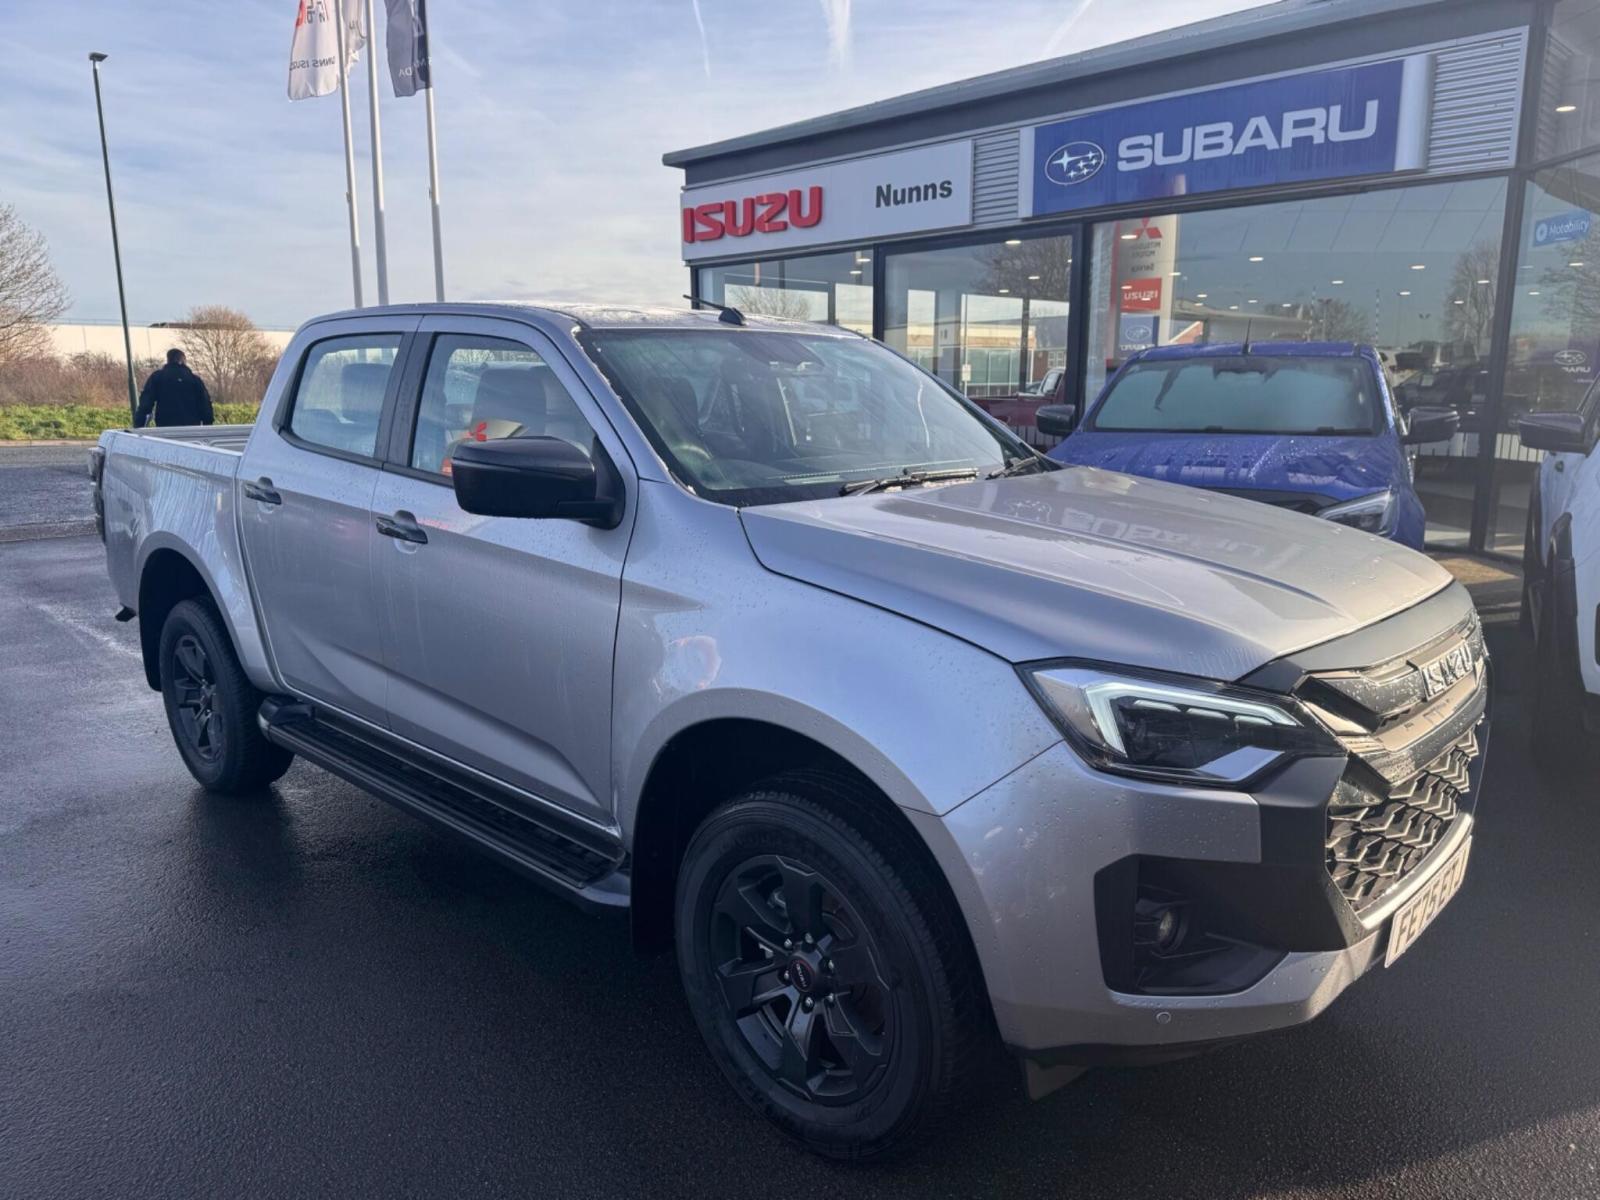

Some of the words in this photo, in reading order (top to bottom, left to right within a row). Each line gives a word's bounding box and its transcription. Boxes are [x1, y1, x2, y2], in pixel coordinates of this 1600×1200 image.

[1117, 99, 1379, 172] SUBARU
[682, 186, 823, 243] ISUZU
[875, 180, 953, 208] Nunns
[1421, 641, 1472, 698] ISUZU
[1395, 880, 1440, 955] FE75
